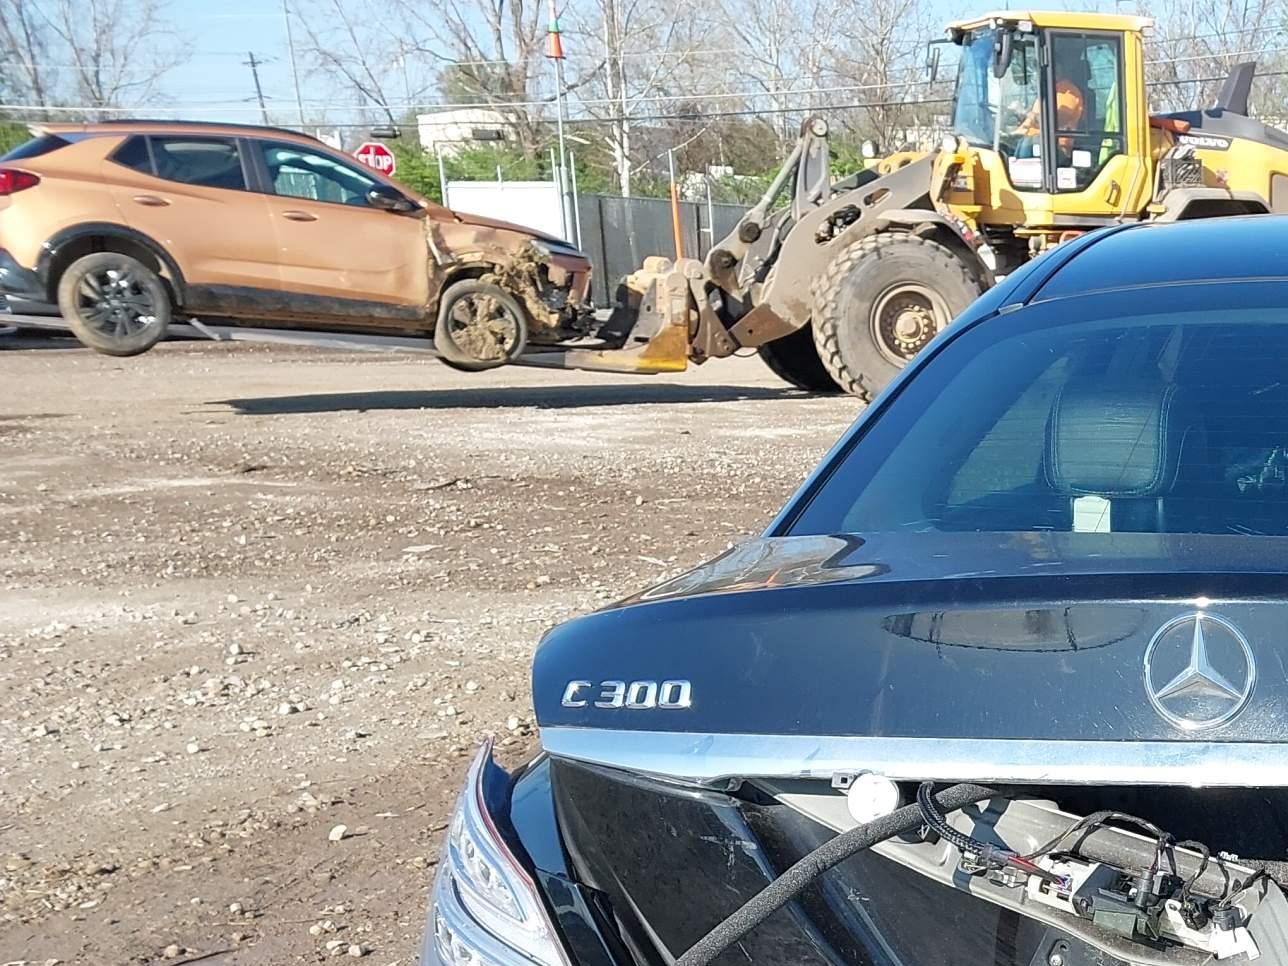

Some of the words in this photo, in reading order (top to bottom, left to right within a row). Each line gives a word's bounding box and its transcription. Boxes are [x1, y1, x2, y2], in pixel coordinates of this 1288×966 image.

[1178, 135, 1229, 147] VOLVO
[358, 154, 391, 170] STOP
[561, 679, 592, 709] C
[594, 679, 692, 709] 300
